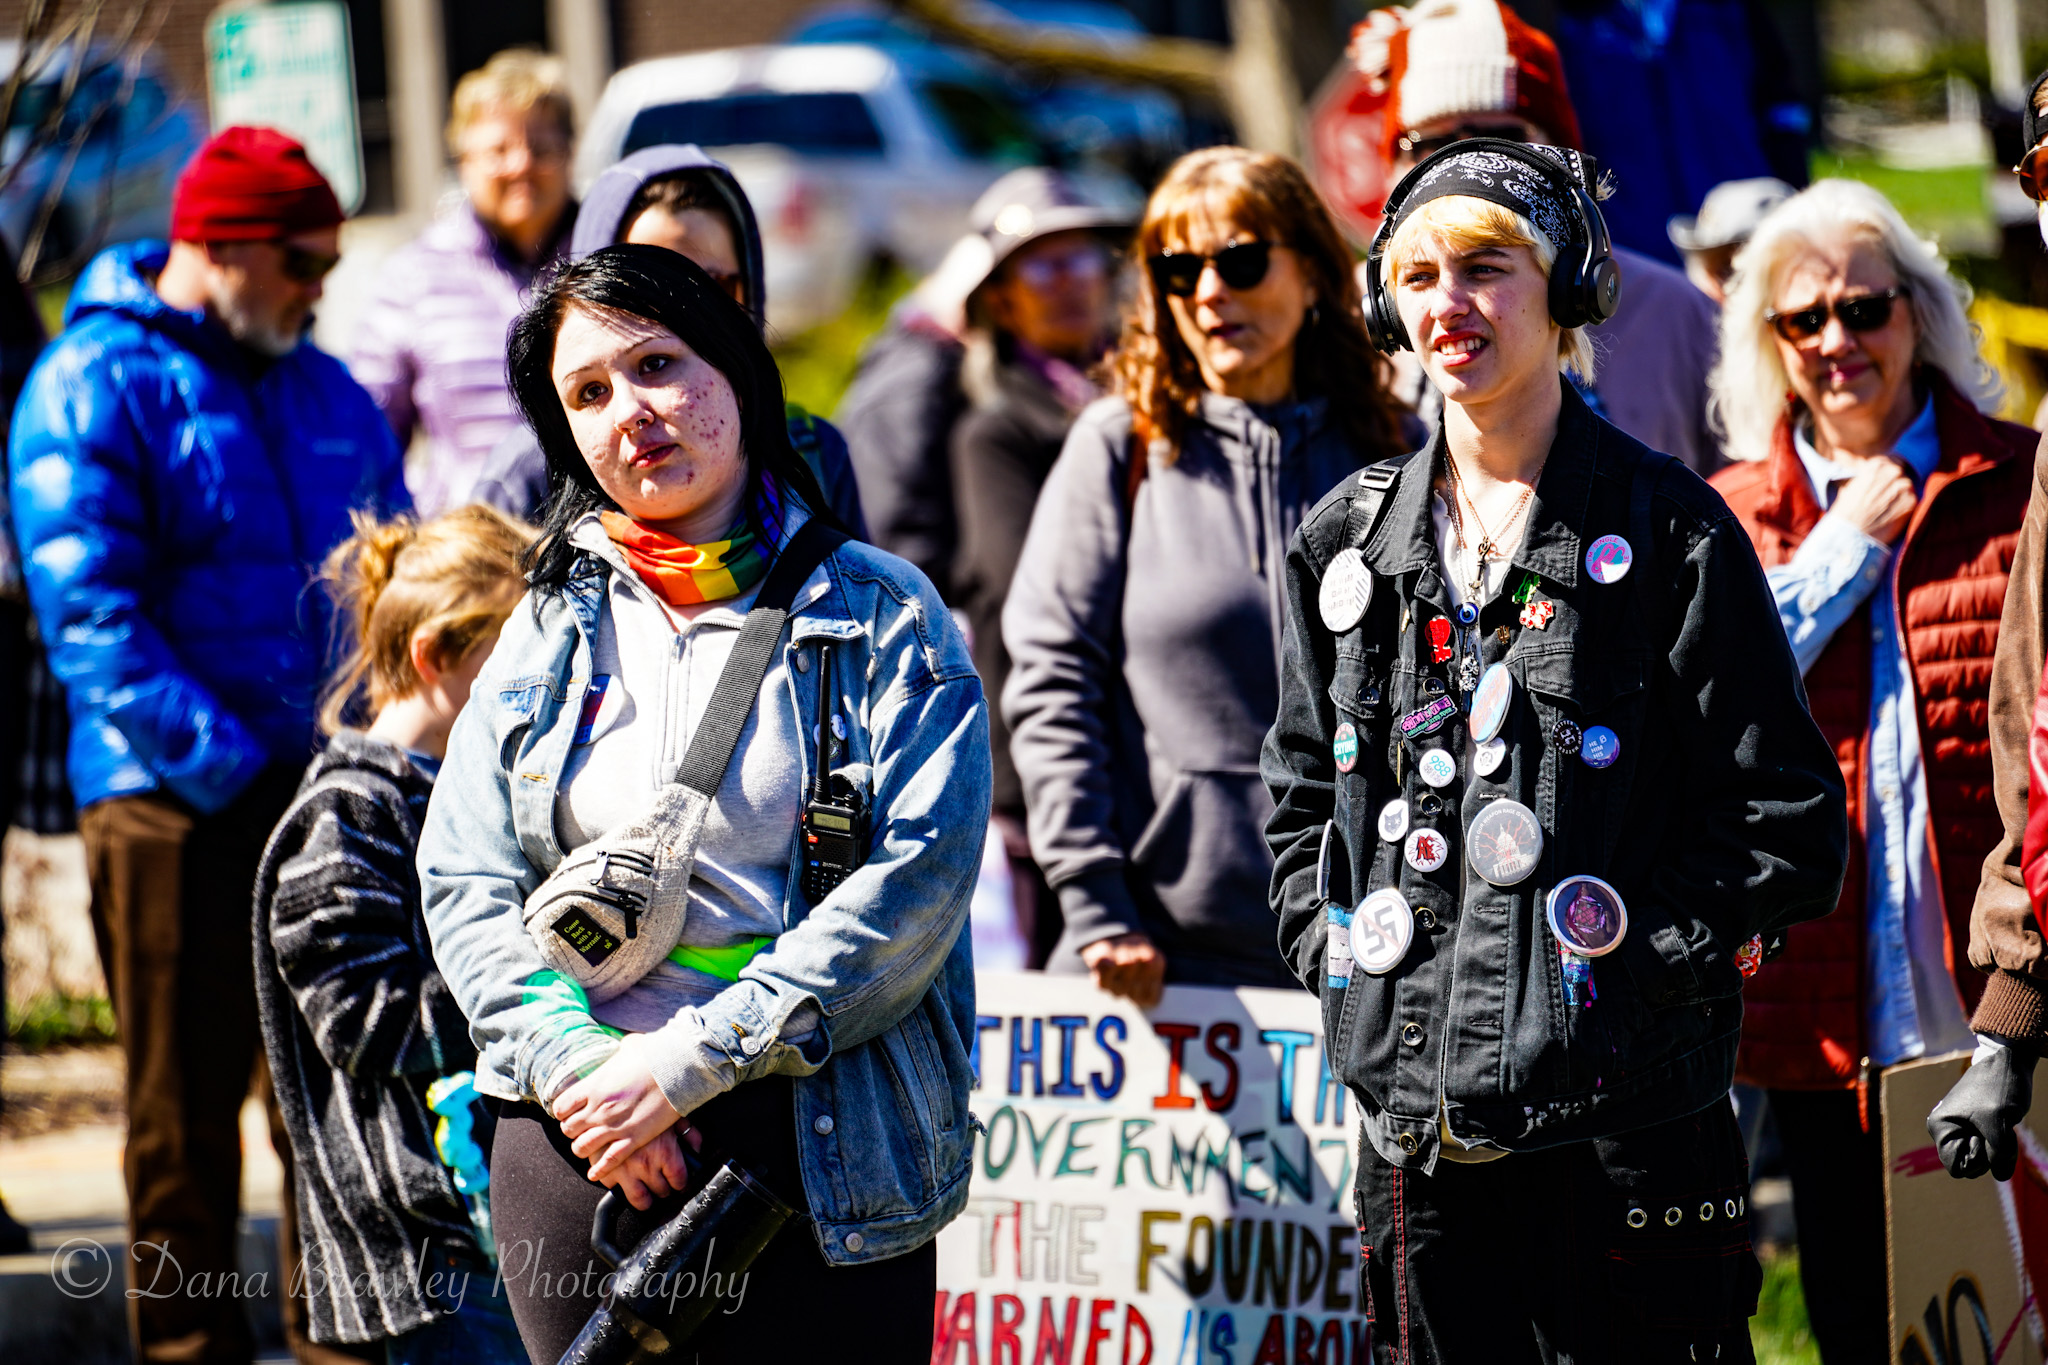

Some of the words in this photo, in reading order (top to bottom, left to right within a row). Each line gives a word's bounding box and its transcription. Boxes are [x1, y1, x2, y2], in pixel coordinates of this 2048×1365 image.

[1593, 536, 1619, 549] SINGLE
[1591, 745, 1604, 753] HIM
[1593, 751, 1604, 759] HIS
[1429, 755, 1451, 777] 988
[1477, 825, 1485, 835] OUR
[1484, 811, 1503, 824] WEAPON
[1521, 814, 1529, 824] OUR
[1527, 824, 1536, 839] VOICE
[564, 919, 580, 934] Come
[571, 926, 585, 939] Back
[577, 934, 589, 945] with
[970, 1015, 1129, 1099] THIS
[1152, 1022, 1242, 1113] IS
[1260, 1029, 1347, 1125] TH
[983, 1105, 1352, 1213] OVERNMENT
[963, 1198, 1107, 1287] THE
[1136, 1210, 1362, 1312] FOUNDE
[1252, 1313, 1371, 1365] ABOU
